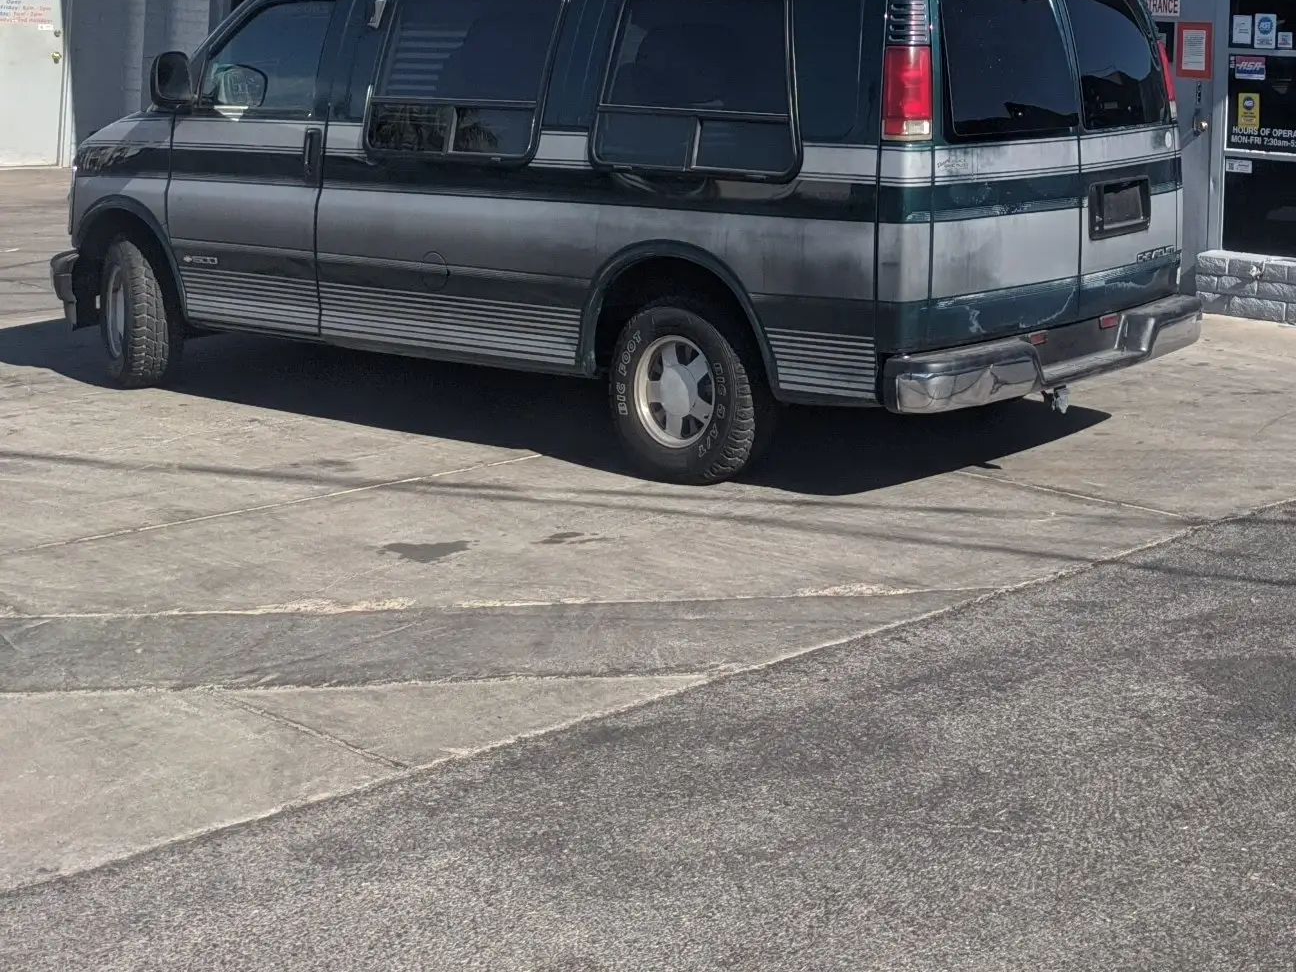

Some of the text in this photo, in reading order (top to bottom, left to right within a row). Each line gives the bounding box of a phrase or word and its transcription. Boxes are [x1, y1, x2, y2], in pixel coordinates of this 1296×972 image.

[1232, 126, 1258, 135] HOURS
[1260, 128, 1271, 136] OF
[1231, 135, 1261, 144] MON-FRI
[617, 330, 641, 415] BIG FOOT
